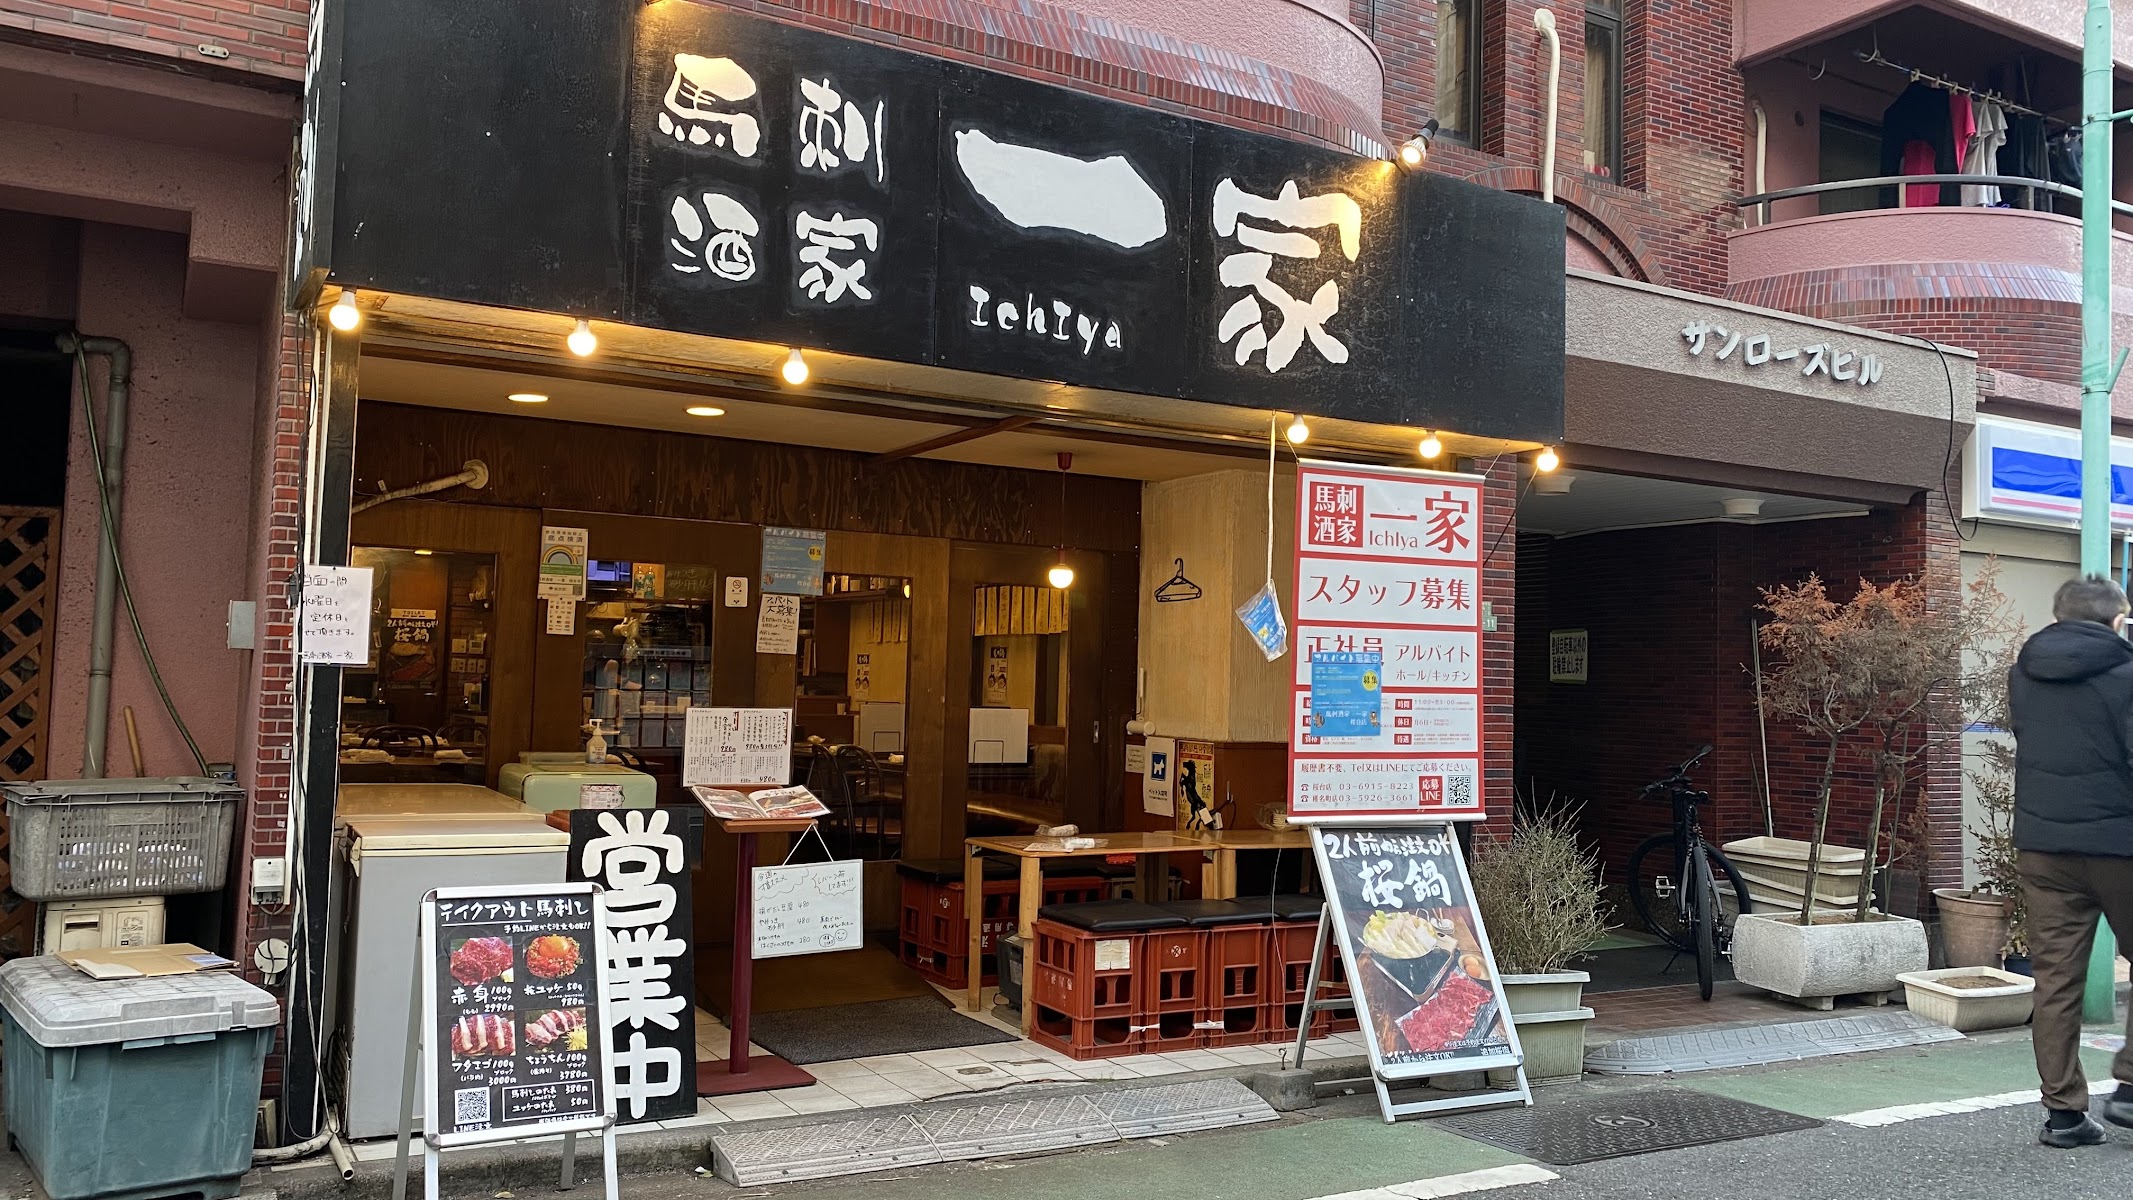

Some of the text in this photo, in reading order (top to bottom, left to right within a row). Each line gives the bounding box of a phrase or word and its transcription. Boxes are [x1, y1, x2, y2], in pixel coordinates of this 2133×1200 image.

[658, 53, 883, 183] 馬刺
[670, 193, 879, 303] 酒家
[1681, 319, 1884, 386] サンローズビル
[1313, 485, 1357, 514] 馬刺
[1313, 515, 1357, 545] 酒家
[1369, 491, 1471, 554] 一家
[1306, 574, 1470, 611] スタッフ募集
[1395, 644, 1471, 663] アルバイト
[1396, 670, 1471, 683] ホール/キッチン
[1397, 718, 1410, 726] 休日
[1420, 790, 1441, 801] LINE
[1421, 779, 1439, 790] 応募
[1358, 859, 1453, 908] 桜鍋
[582, 809, 687, 1120] 営業中
